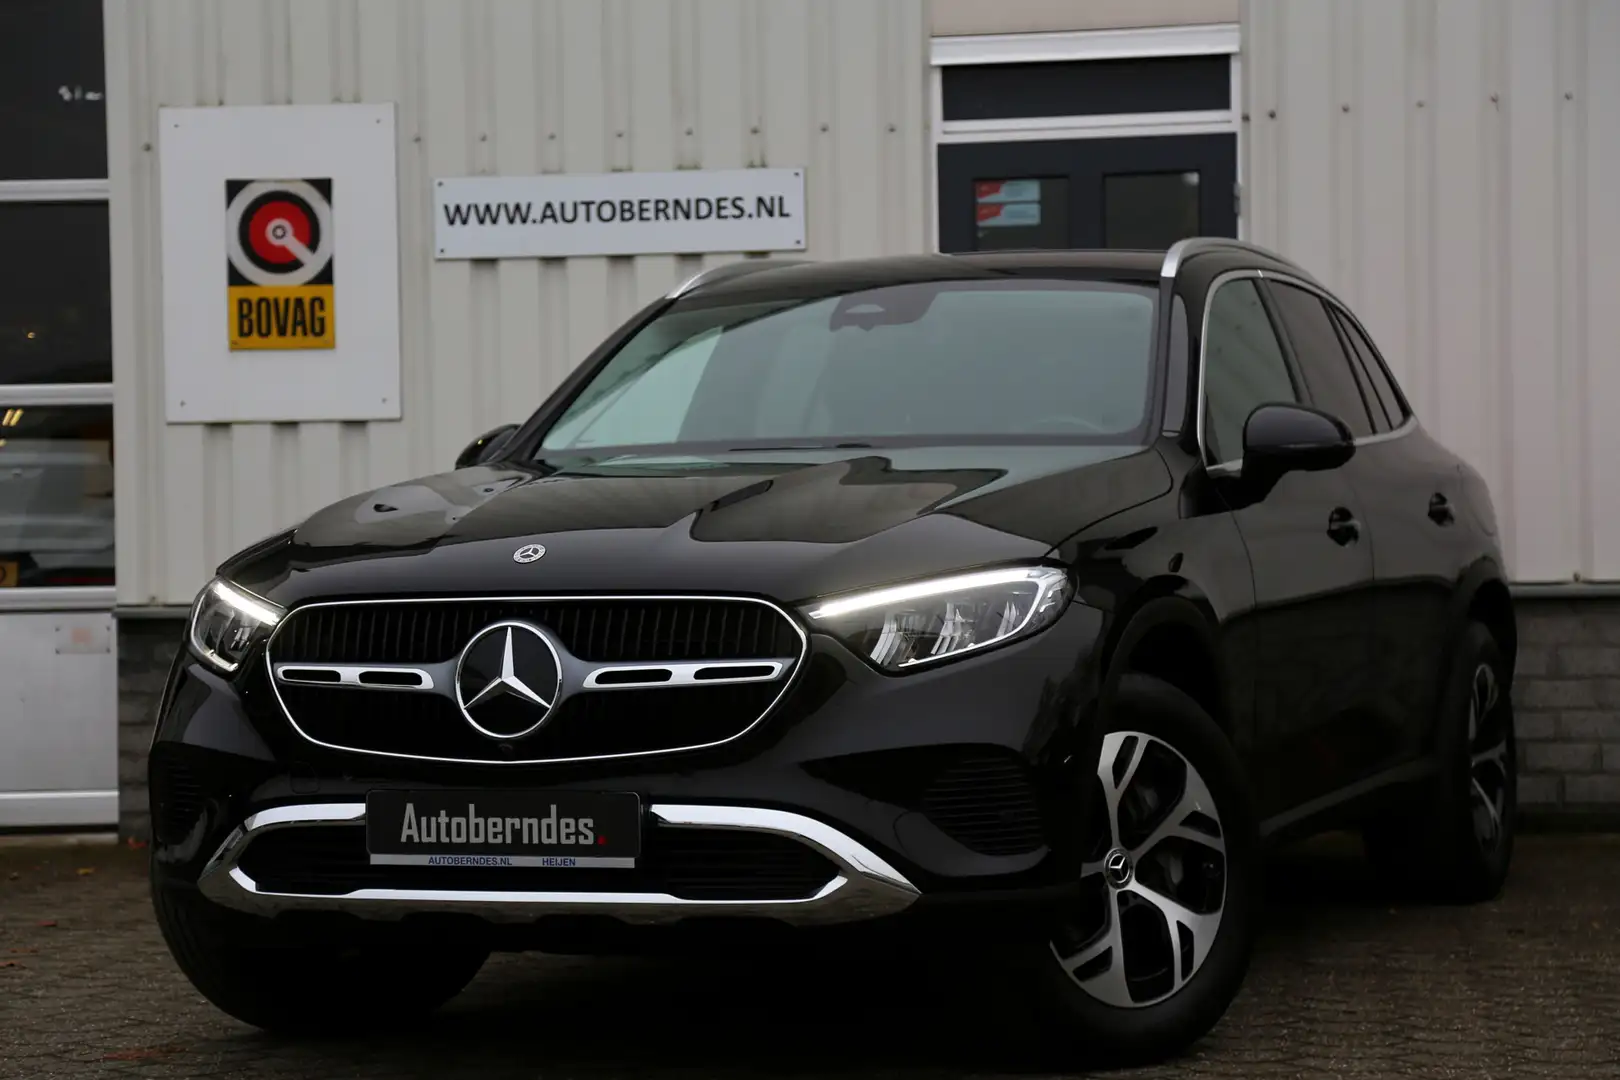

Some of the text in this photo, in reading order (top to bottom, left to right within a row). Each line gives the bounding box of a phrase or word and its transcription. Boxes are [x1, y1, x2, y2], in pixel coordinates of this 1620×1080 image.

[444, 196, 791, 226] WWW.AUTOBERNDES.NL
[237, 297, 326, 338] BOVAG
[428, 856, 576, 867] AUTOBERNDES.NL HEIJEN
